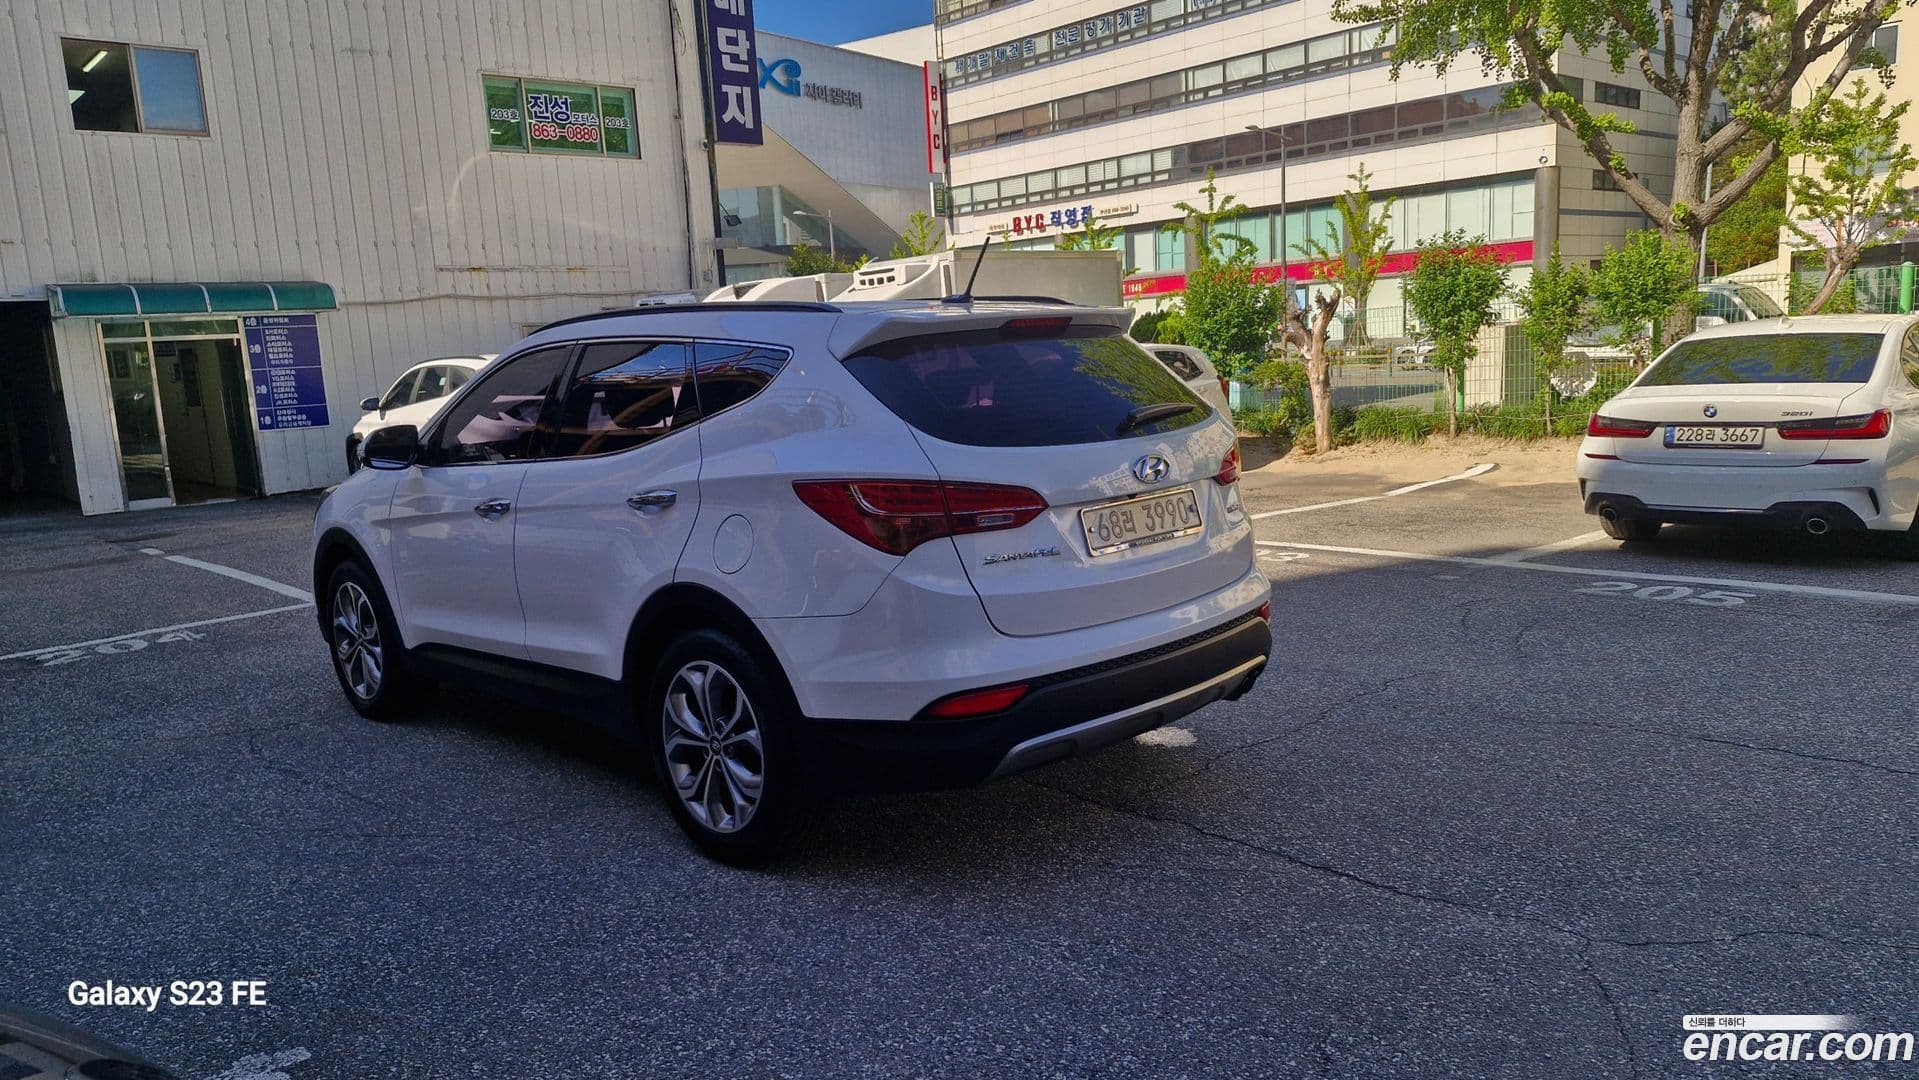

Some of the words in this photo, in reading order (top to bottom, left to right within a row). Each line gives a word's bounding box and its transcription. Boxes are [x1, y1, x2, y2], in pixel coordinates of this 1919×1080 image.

[490, 108, 519, 121] 203호
[530, 94, 570, 123] 진성
[573, 113, 598, 125] 모터스
[930, 85, 941, 150] BYC
[533, 123, 599, 143] 863-0880
[605, 117, 630, 129] 203호
[1012, 212, 1046, 233] BYC
[1719, 427, 1760, 442] 3667
[1141, 497, 1189, 532] 3990
[1574, 580, 1757, 607] 205
